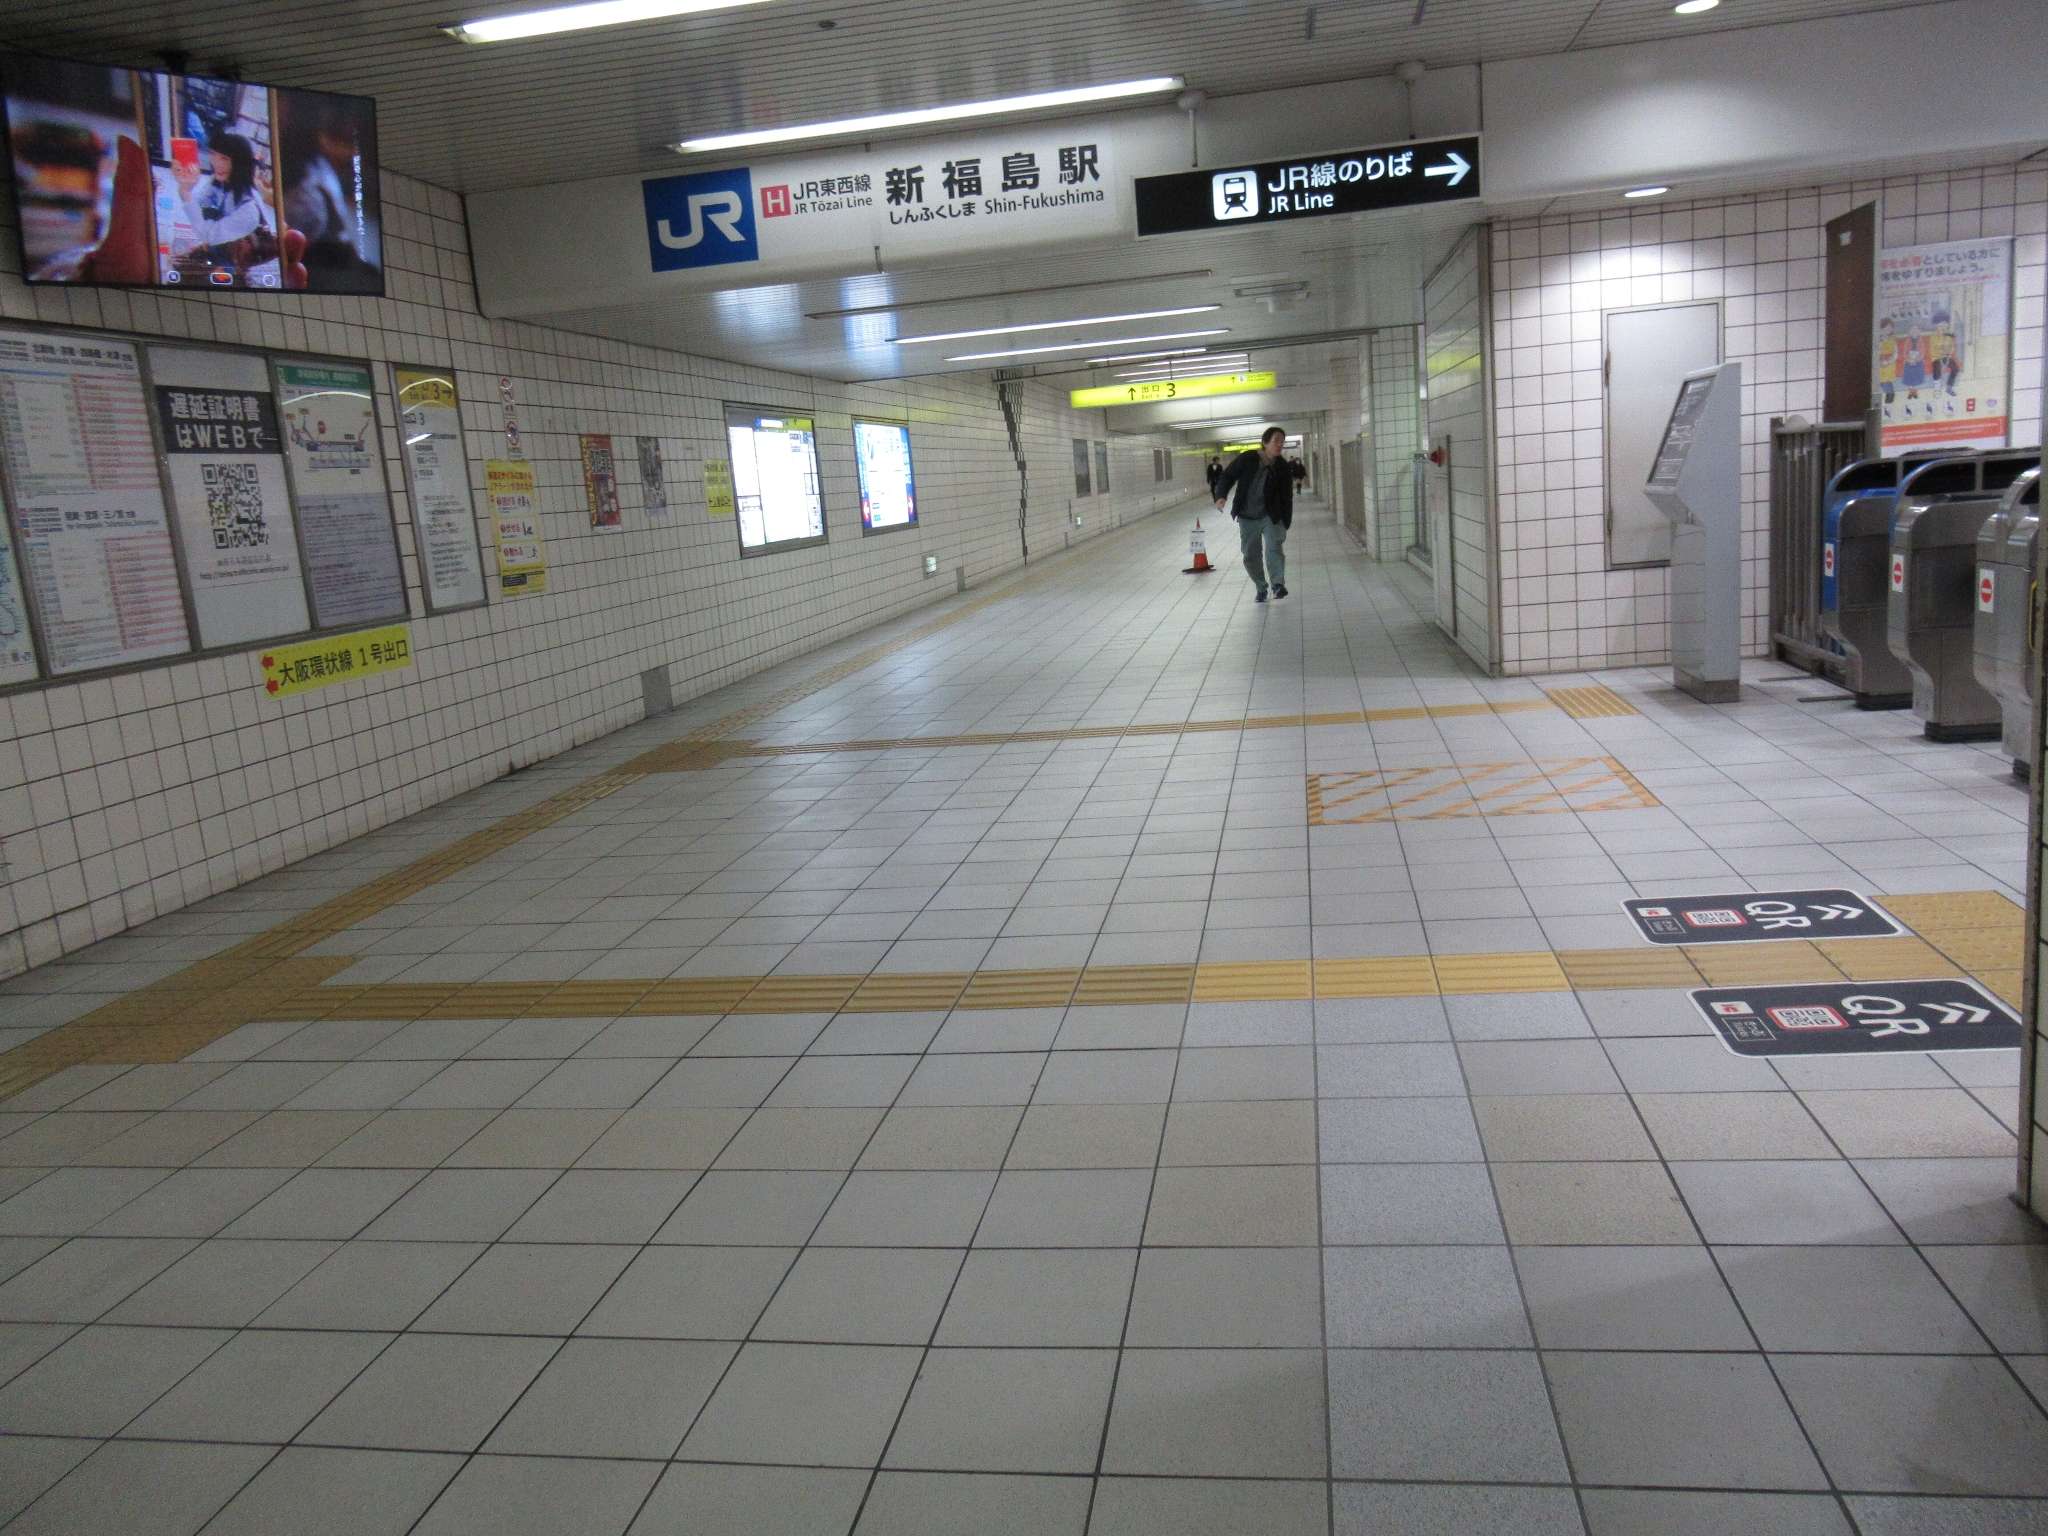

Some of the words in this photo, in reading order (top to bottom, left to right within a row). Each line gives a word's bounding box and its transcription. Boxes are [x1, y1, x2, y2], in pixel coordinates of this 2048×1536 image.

[885, 143, 1101, 206] 新福島駅
[1267, 150, 1414, 193] JR線のりば
[766, 189, 785, 214] H
[793, 173, 872, 201] JR東西線
[984, 187, 1105, 215] Shin-Fukushima
[794, 203, 808, 215] JR
[847, 195, 874, 209] Line
[889, 201, 977, 225] しんふくしま
[1267, 195, 1290, 214] JR
[1294, 192, 1335, 211] Line
[656, 190, 746, 250] JR
[1166, 382, 1176, 398] 3
[168, 391, 260, 421] 遅延証明書
[278, 648, 354, 687] 大阪環状線
[1744, 900, 1812, 931] QR
[1840, 994, 1931, 1038] QR
